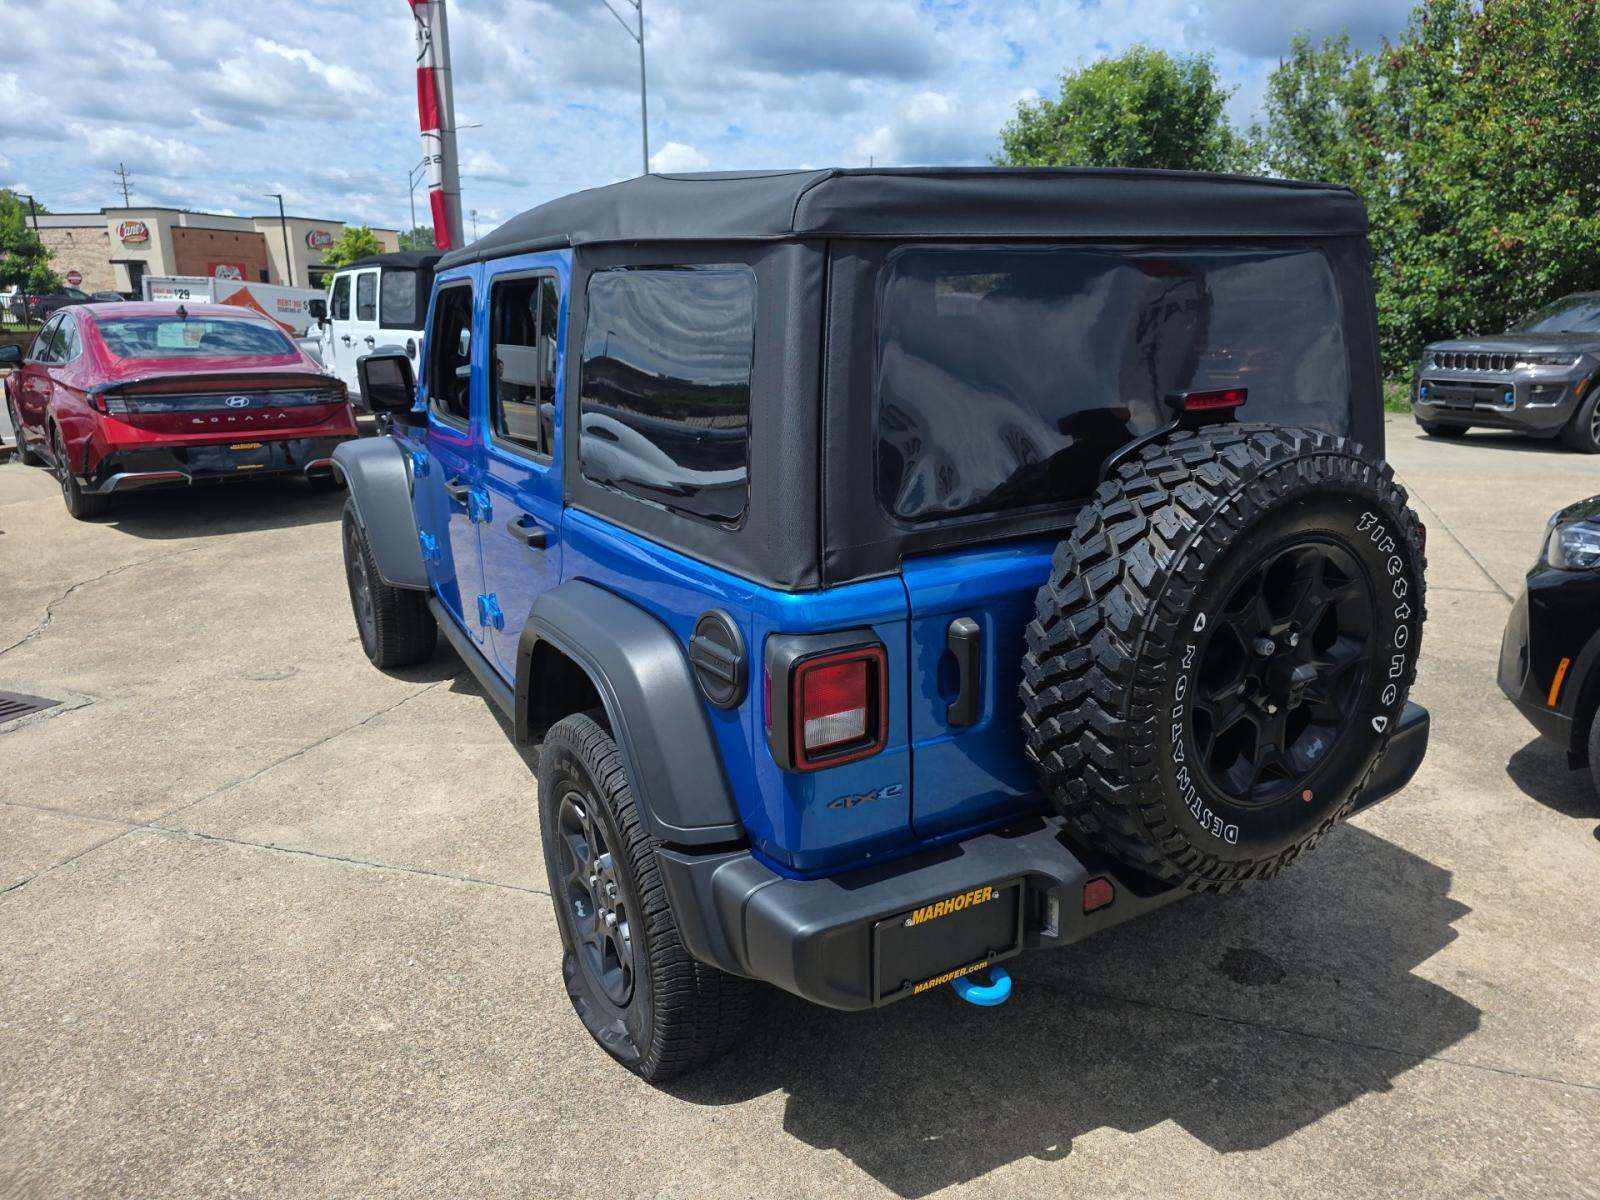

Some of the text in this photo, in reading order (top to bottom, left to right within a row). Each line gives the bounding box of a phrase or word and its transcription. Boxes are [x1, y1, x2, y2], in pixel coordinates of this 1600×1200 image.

[192, 413, 286, 424] SONATA
[1172, 645, 1239, 845] DESTINATION
[911, 886, 993, 925] MARHOFER
[913, 961, 988, 995] MARHOFER.com
